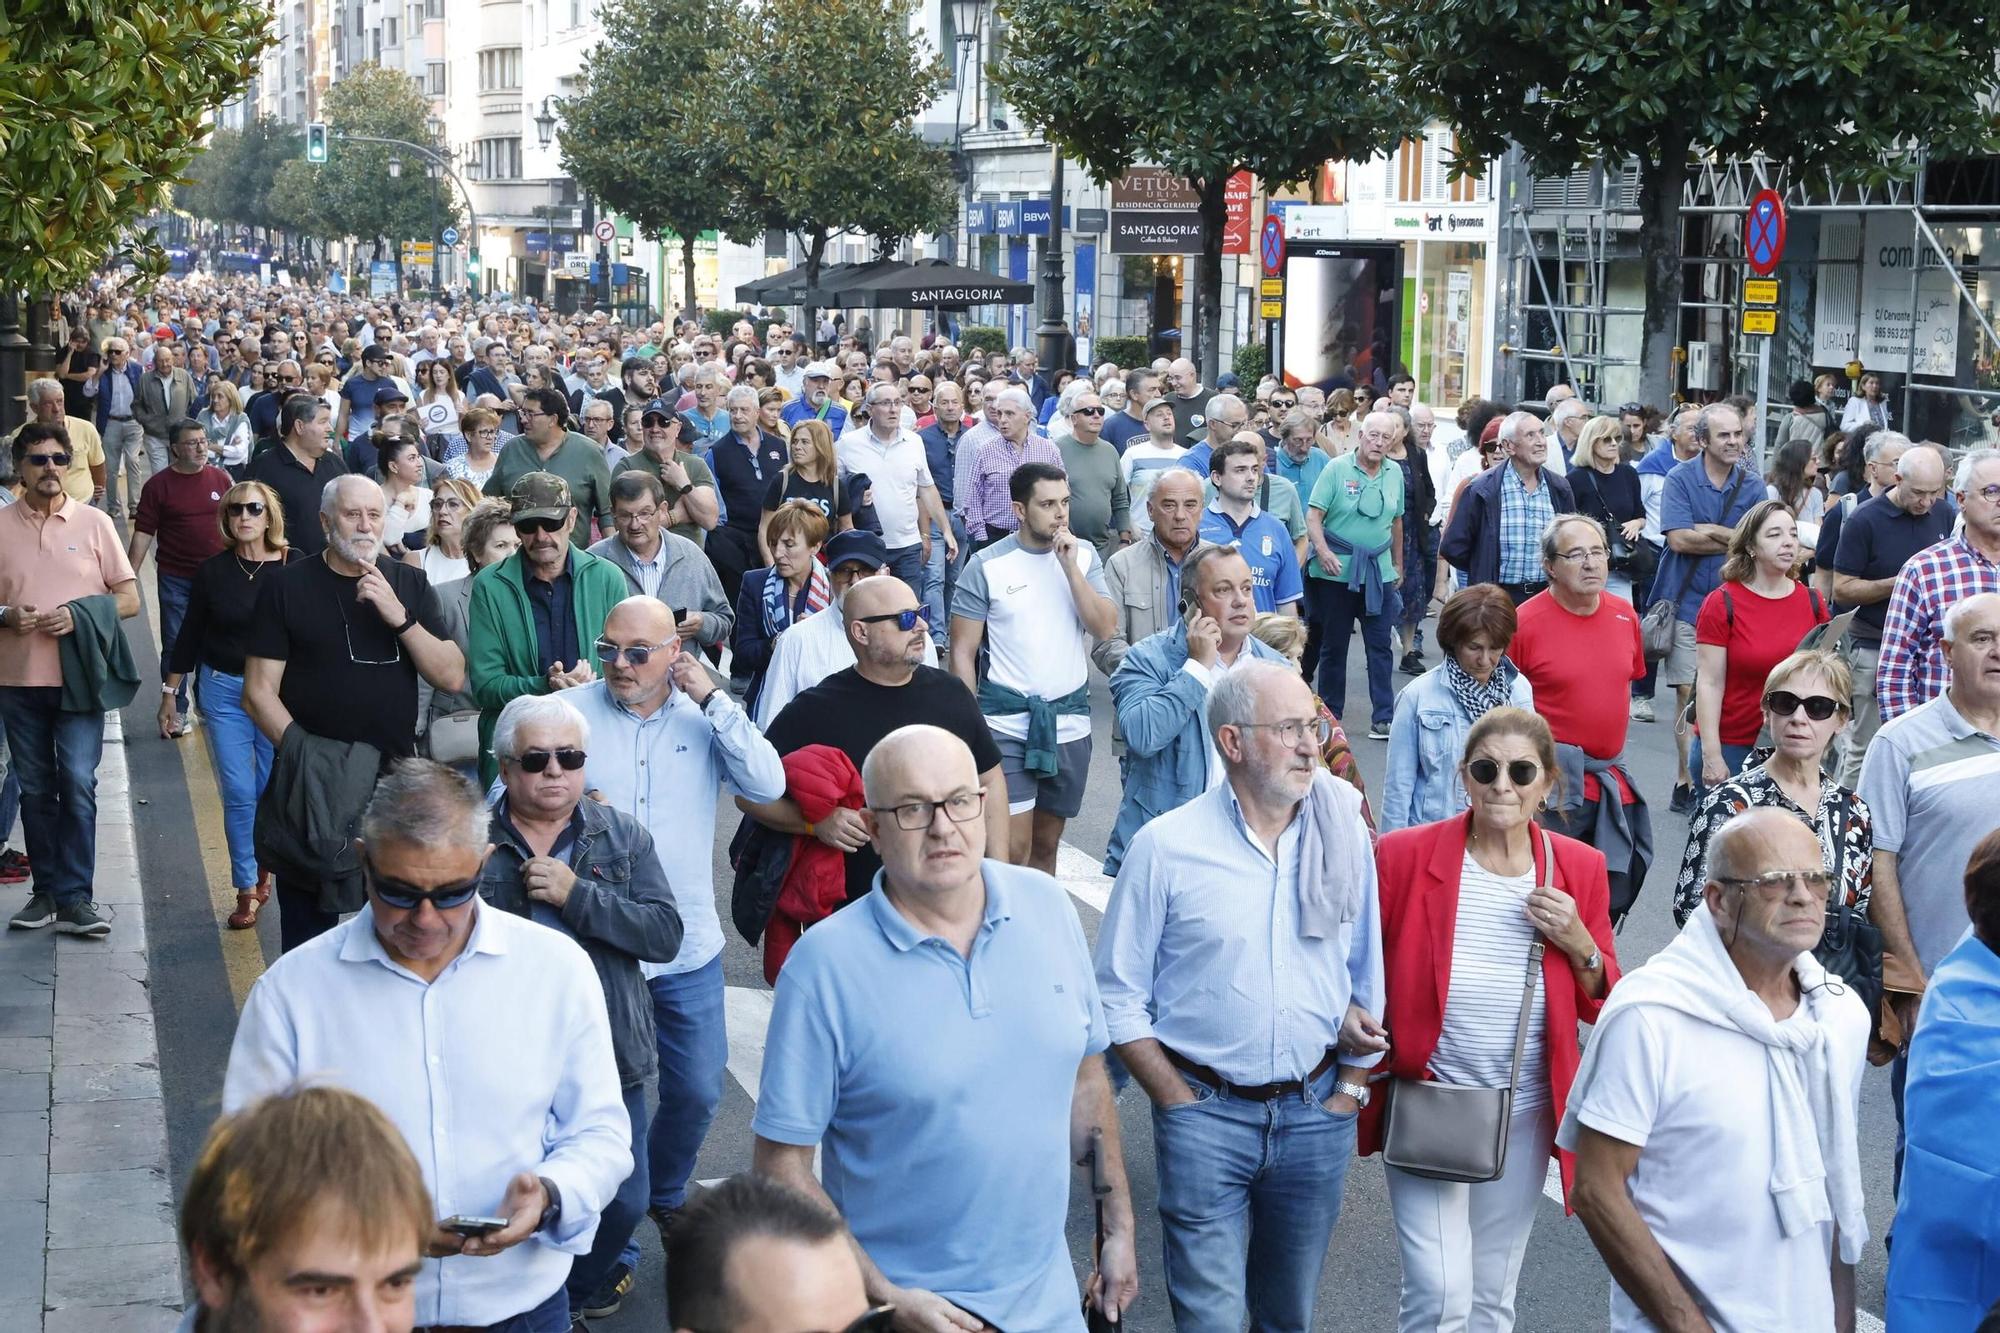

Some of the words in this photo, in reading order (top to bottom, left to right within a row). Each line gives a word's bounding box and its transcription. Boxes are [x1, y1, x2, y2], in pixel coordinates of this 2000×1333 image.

[1116, 201, 1161, 209] RESIDENCIA
[1225, 202, 1244, 213] AFÉ
[968, 208, 985, 228] BBVA
[998, 208, 1015, 228] BBVA
[1120, 225, 1198, 236] SANTAGLORIA
[911, 288, 1003, 302] SANTAGLORIA
